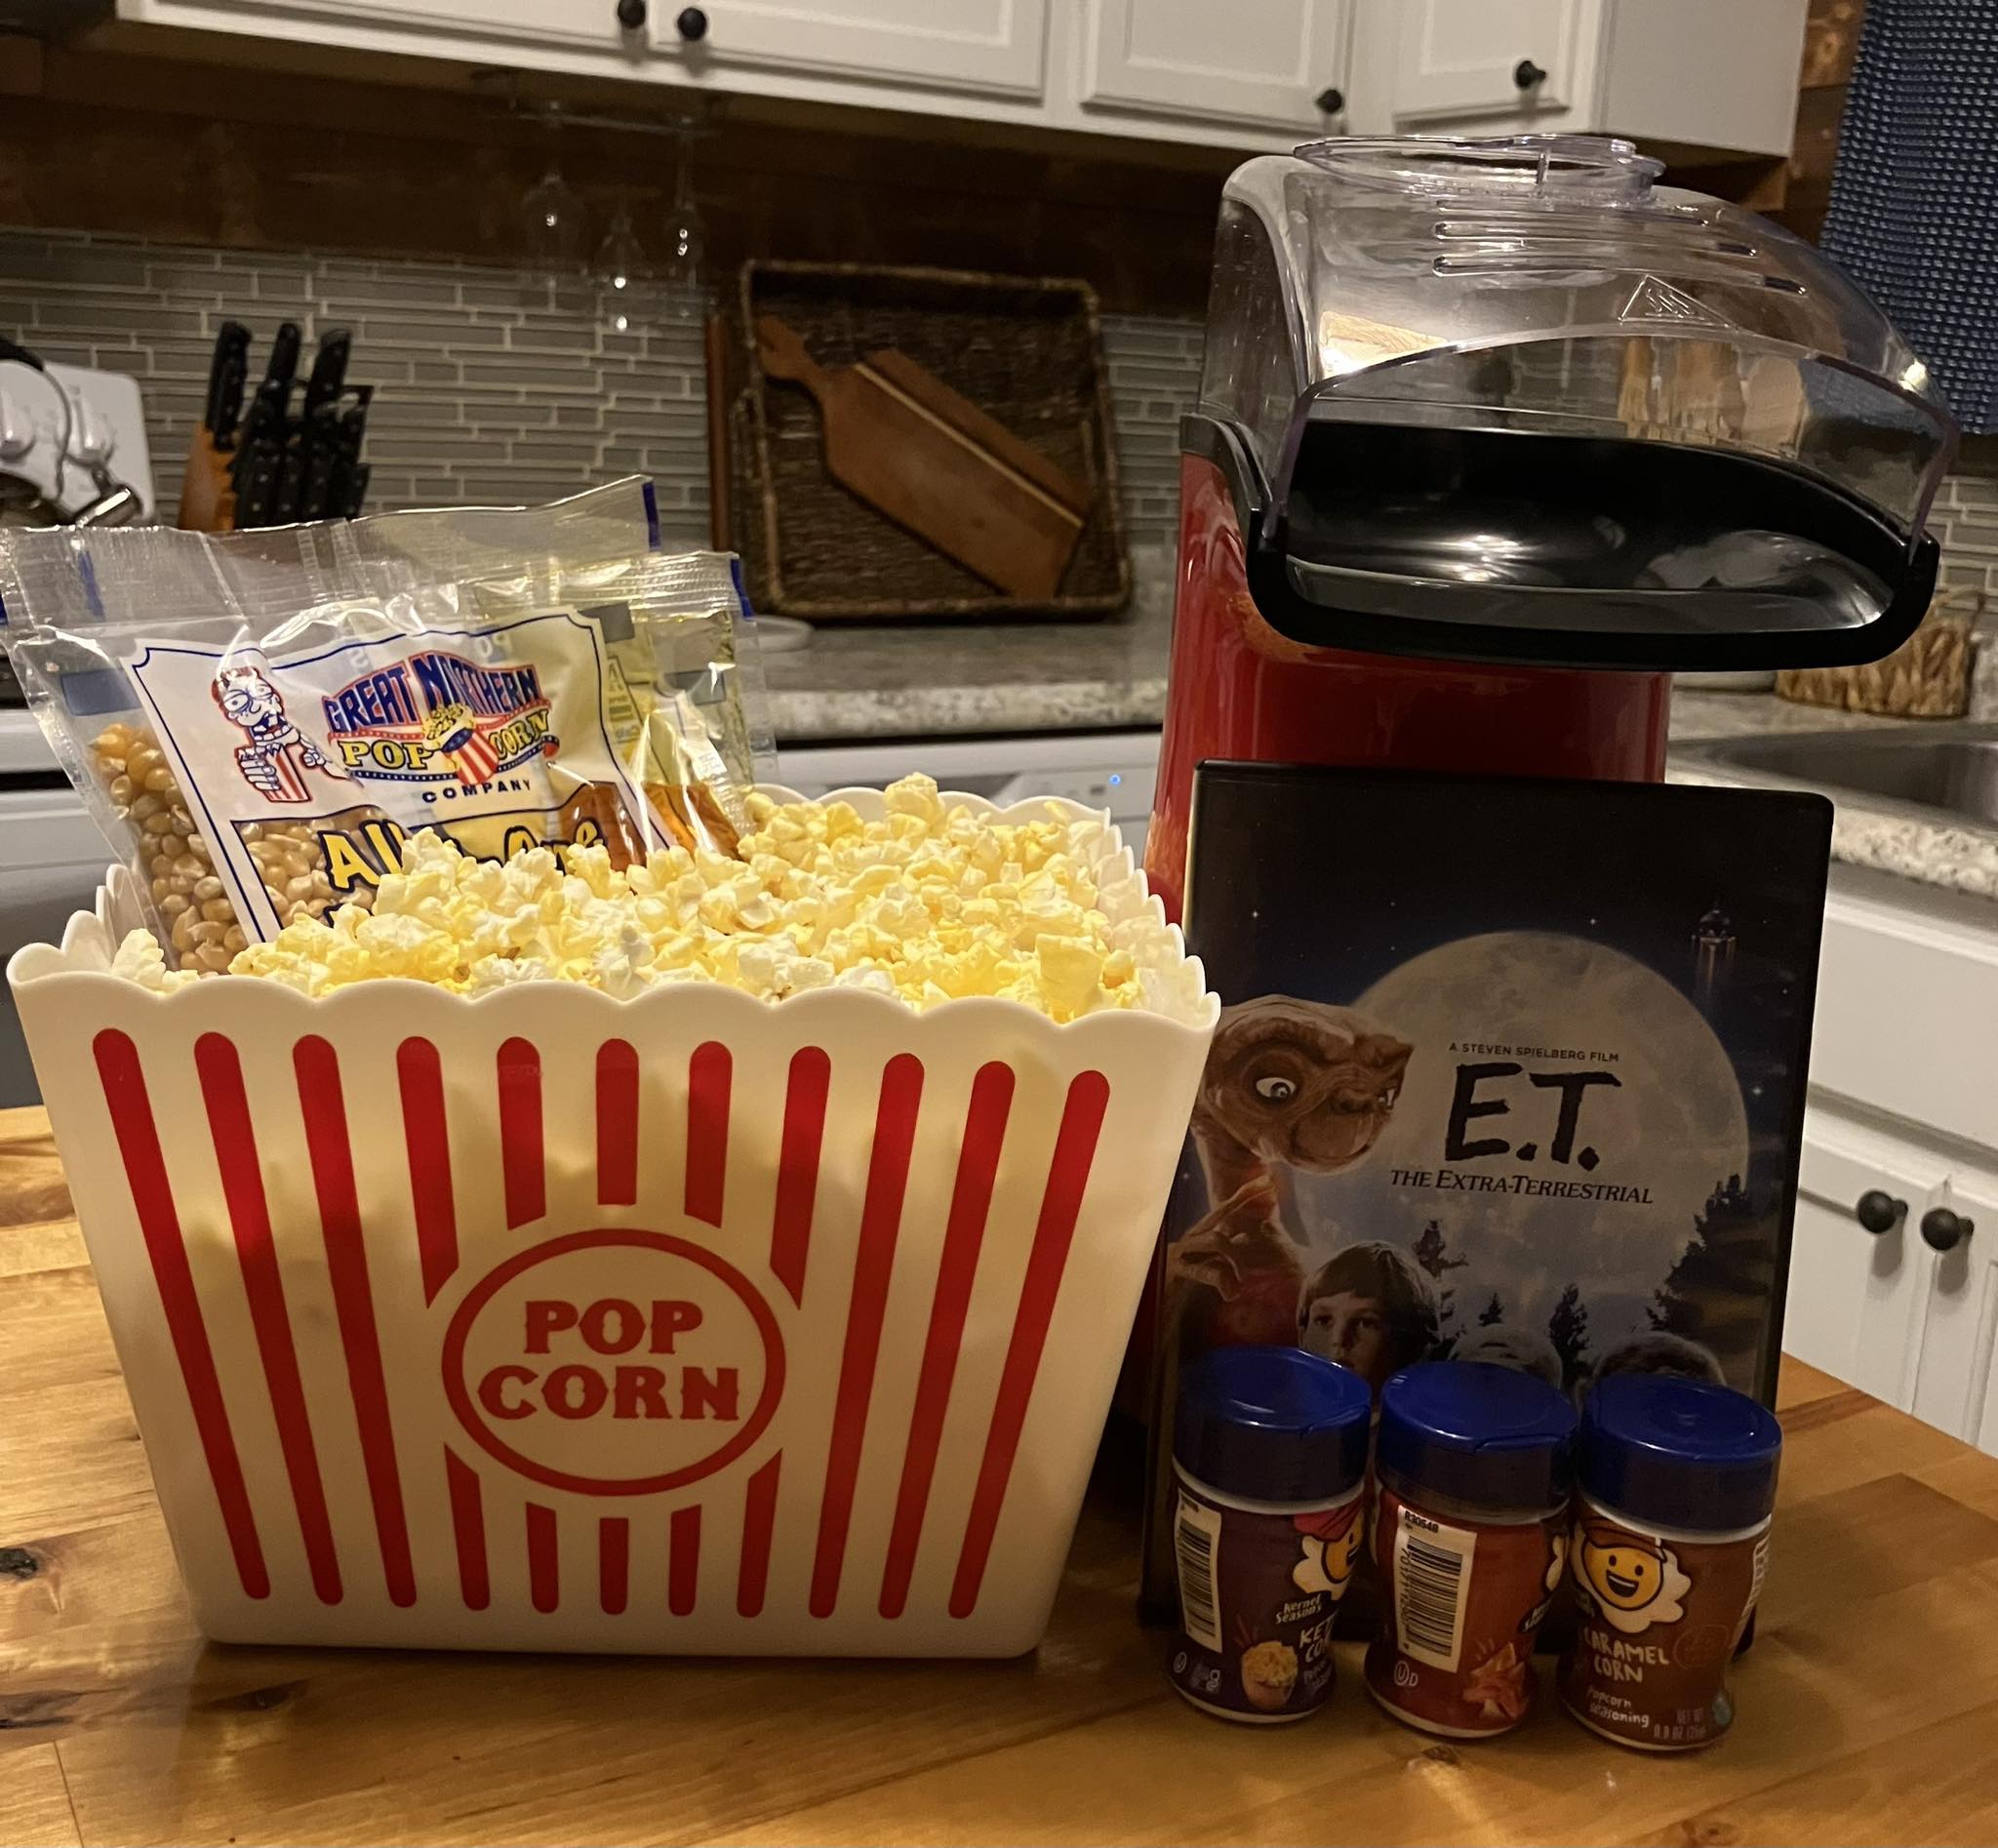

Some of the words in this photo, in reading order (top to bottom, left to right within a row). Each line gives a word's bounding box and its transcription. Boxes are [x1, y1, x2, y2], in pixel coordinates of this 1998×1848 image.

[324, 665, 419, 733] GREAT
[338, 739, 434, 771] POP
[489, 708, 549, 761] CORN
[421, 778, 532, 804] COMPANY
[1449, 1042, 1459, 1052] A
[1462, 1043, 1512, 1056] STEVEN
[1516, 1047, 1586, 1061] SPIELBERG
[1589, 1051, 1620, 1063] FILM
[1444, 1062, 1622, 1171] E.T.
[1390, 1170, 1432, 1187] THE
[523, 1298, 703, 1355] POP
[477, 1364, 739, 1421] CORN
[1583, 1626, 1670, 1666] CARAMEL
[1593, 1654, 1644, 1683] CORN
